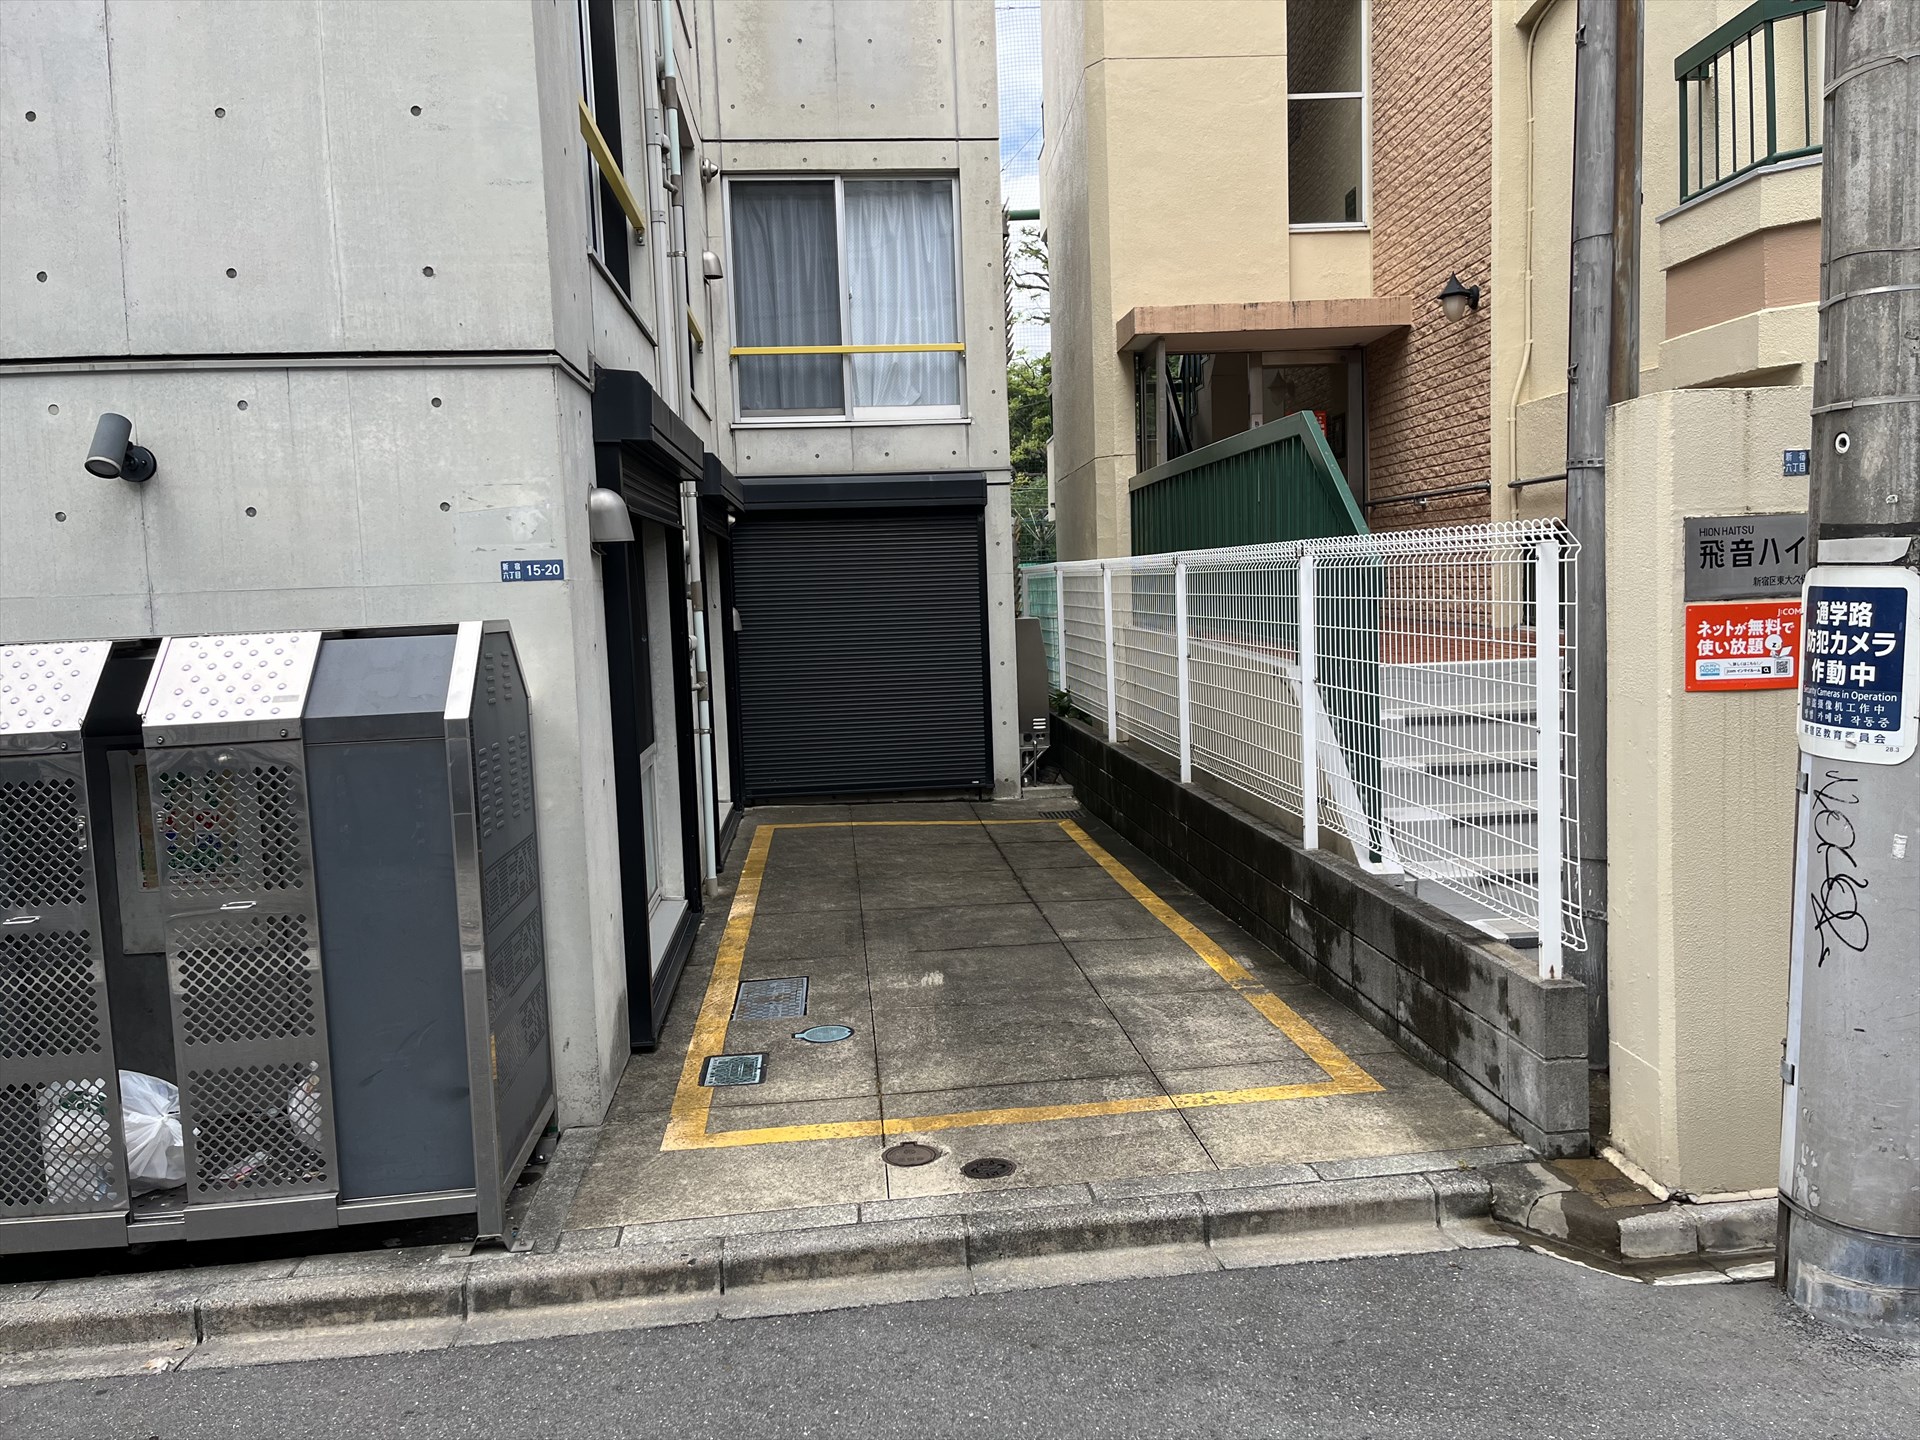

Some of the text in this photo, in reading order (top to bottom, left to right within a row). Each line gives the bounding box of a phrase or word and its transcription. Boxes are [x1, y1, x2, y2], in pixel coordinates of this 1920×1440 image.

[1785, 462, 1806, 473] 六丁目
[1699, 525, 1755, 537] HION HAITSU
[1699, 536, 1806, 570] 飛音ハイ
[502, 570, 521, 580] 六丁目
[526, 563, 561, 576] 15-20
[1816, 601, 1873, 627] 通学路
[1697, 618, 1795, 637] ネットが無料で
[1696, 637, 1764, 657] 使い放題
[1806, 628, 1897, 658] 防犯カメラ
[1811, 657, 1876, 687] 作動中
[1817, 687, 1841, 699] Cameras
[1841, 690, 1850, 699] in
[1851, 691, 1898, 702] Operation
[1817, 711, 1843, 725] 카메라
[1850, 715, 1891, 729] 작동중
